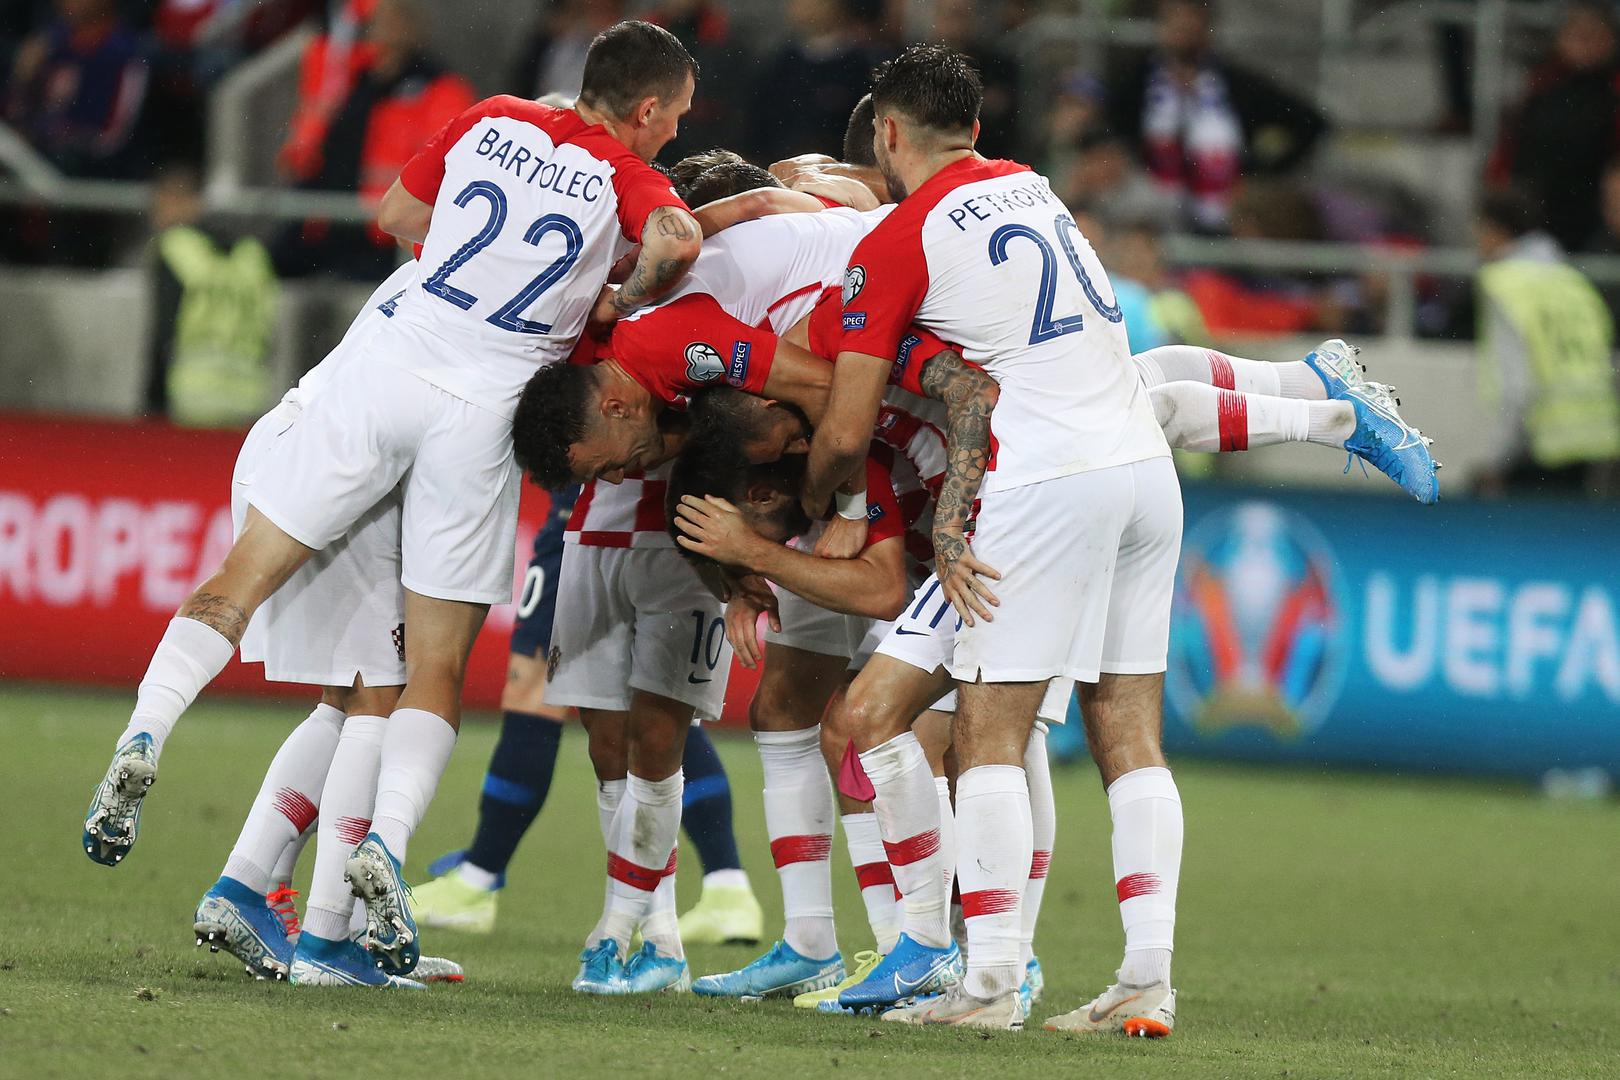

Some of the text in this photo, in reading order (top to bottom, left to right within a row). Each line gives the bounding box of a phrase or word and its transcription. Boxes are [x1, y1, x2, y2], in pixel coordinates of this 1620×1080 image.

[475, 127, 603, 203] BARTOLEC
[422, 180, 584, 335] 22
[988, 213, 1123, 345] 20
[732, 341, 747, 378] RESPECT
[691, 610, 726, 672] 10
[1364, 570, 1620, 706] UEFA
